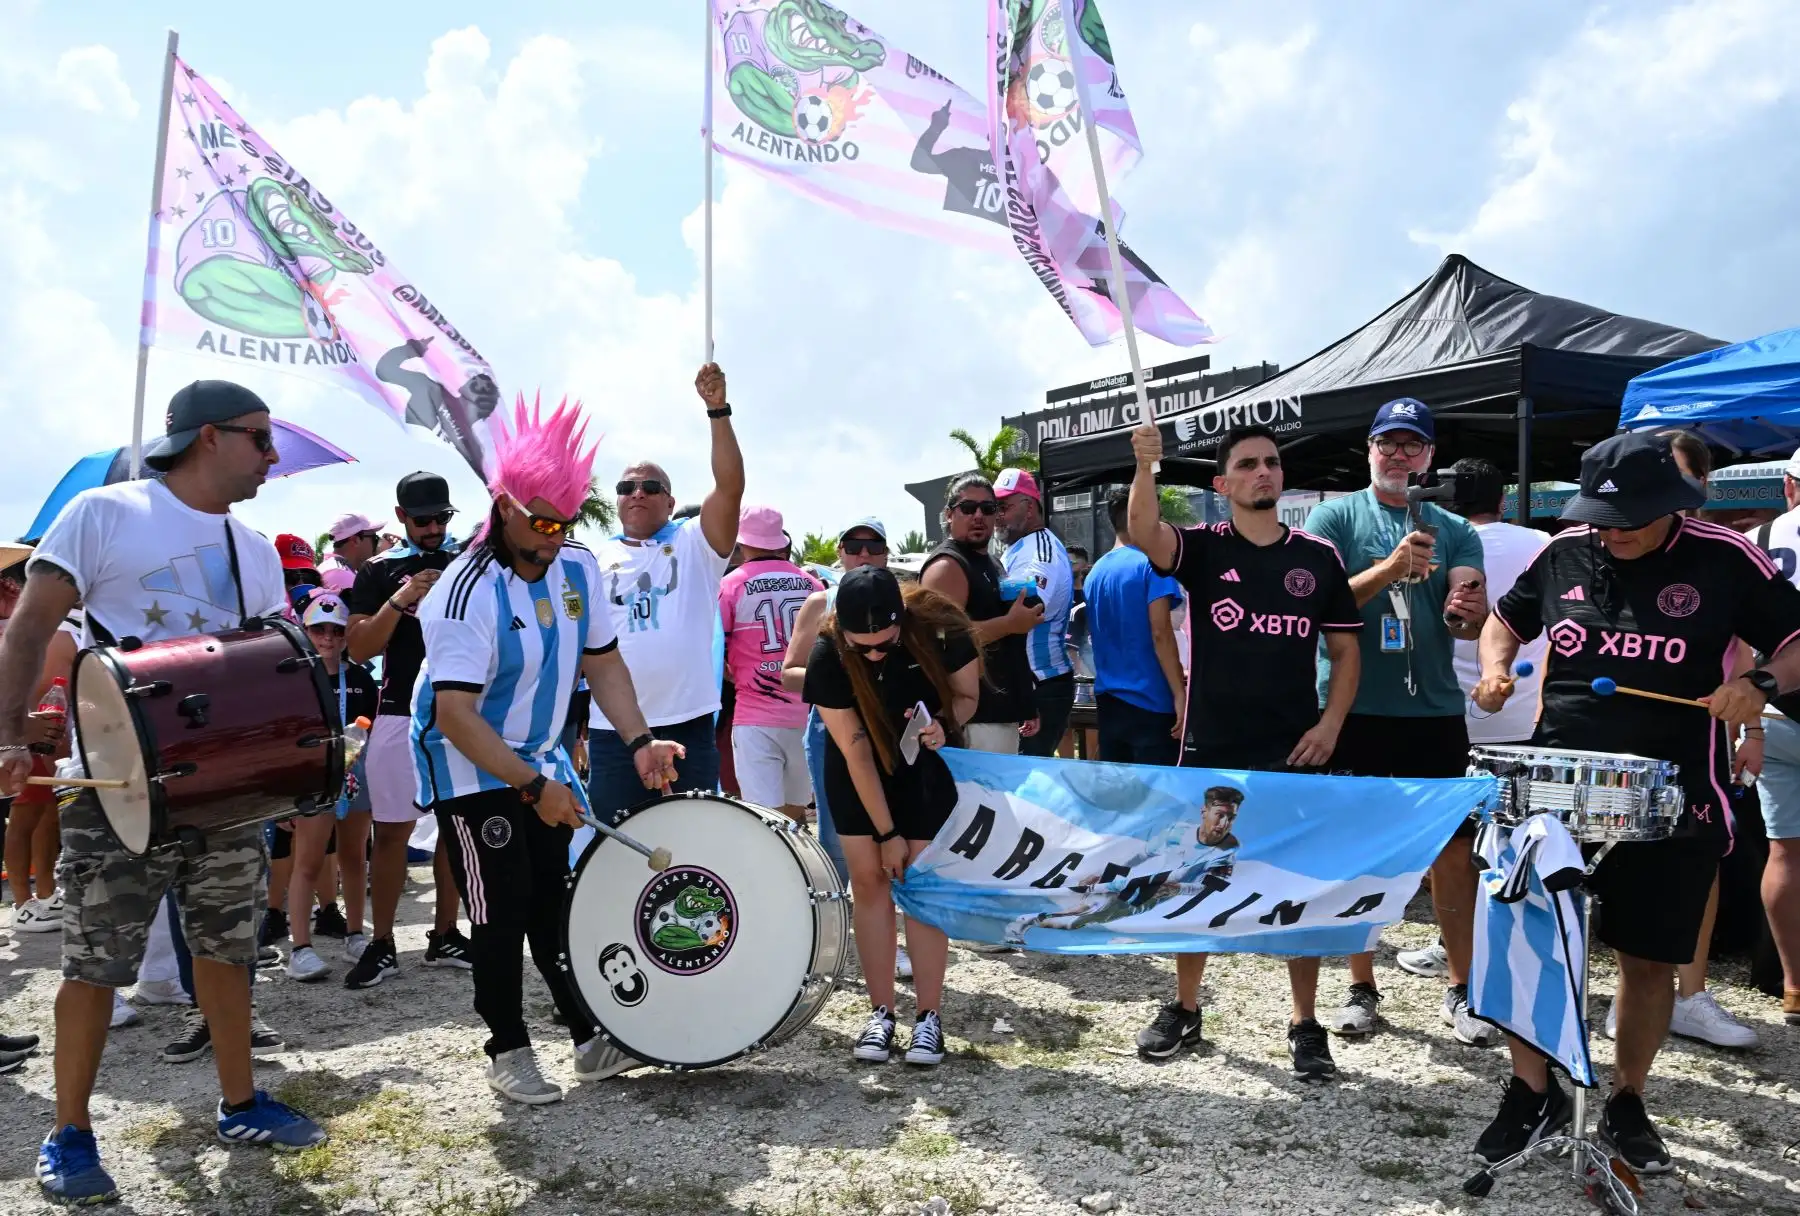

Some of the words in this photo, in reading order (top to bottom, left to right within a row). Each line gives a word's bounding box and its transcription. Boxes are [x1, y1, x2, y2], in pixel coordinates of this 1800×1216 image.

[732, 121, 860, 163] ALENTANDO
[973, 178, 1004, 213] 10
[201, 218, 236, 248] 10
[1090, 374, 1128, 391] AutoNation
[1199, 395, 1303, 435] ORION
[1178, 440, 1197, 451] HIGH
[744, 578, 814, 595] MESSIAS
[1250, 612, 1311, 638] XBTO
[1598, 631, 1687, 664] XBTO
[643, 872, 689, 920] MESSIAS
[659, 930, 730, 968] ALENTANDO
